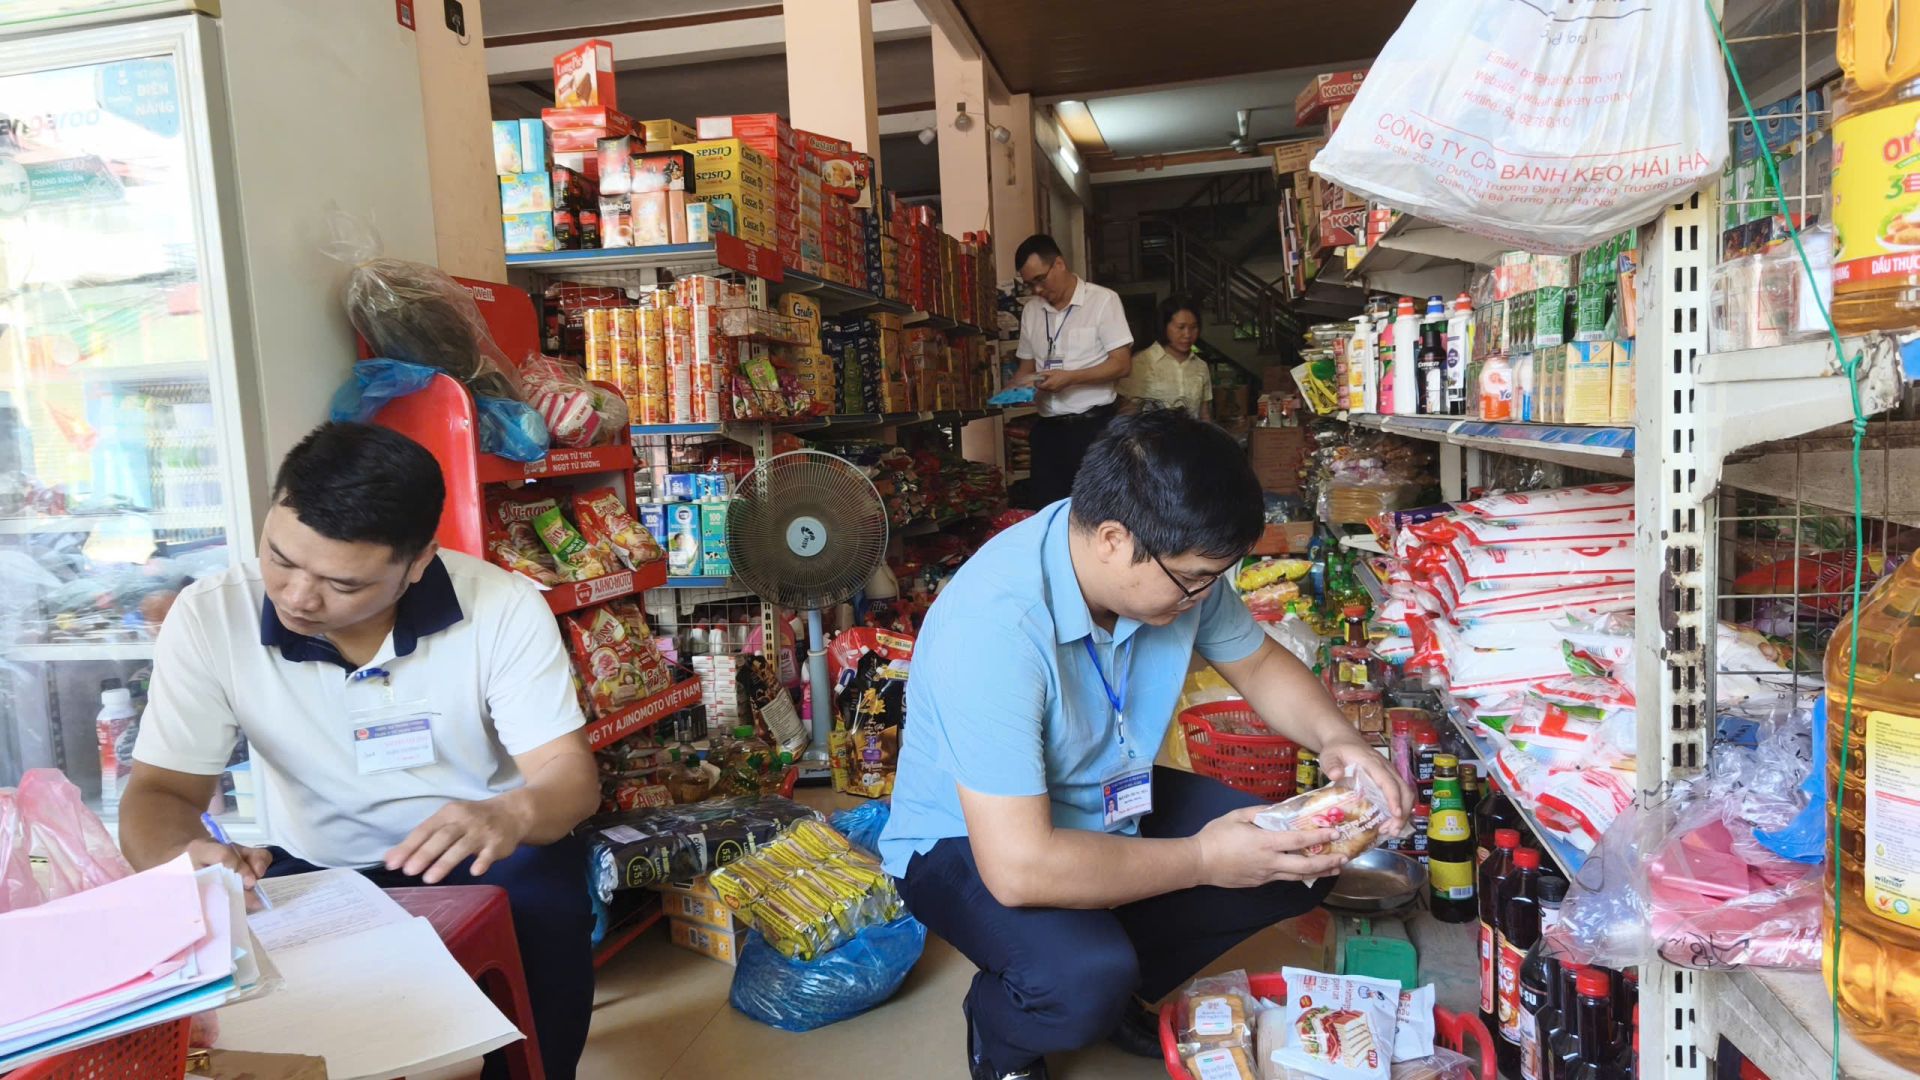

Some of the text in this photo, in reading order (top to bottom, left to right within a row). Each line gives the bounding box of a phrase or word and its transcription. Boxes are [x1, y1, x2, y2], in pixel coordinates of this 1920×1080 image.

[1378, 113, 1711, 184] CÔNG TY CP BÁNH KẸO HẢI HÀ
[1872, 255, 1891, 275] DẦU
[473, 286, 495, 301] Well.
[601, 723, 613, 738] TY
[616, 700, 665, 732] AJINOMOTO
[665, 690, 682, 707] VIỆT
[683, 681, 700, 699] NAM
[1520, 988, 1537, 1006] -SU
